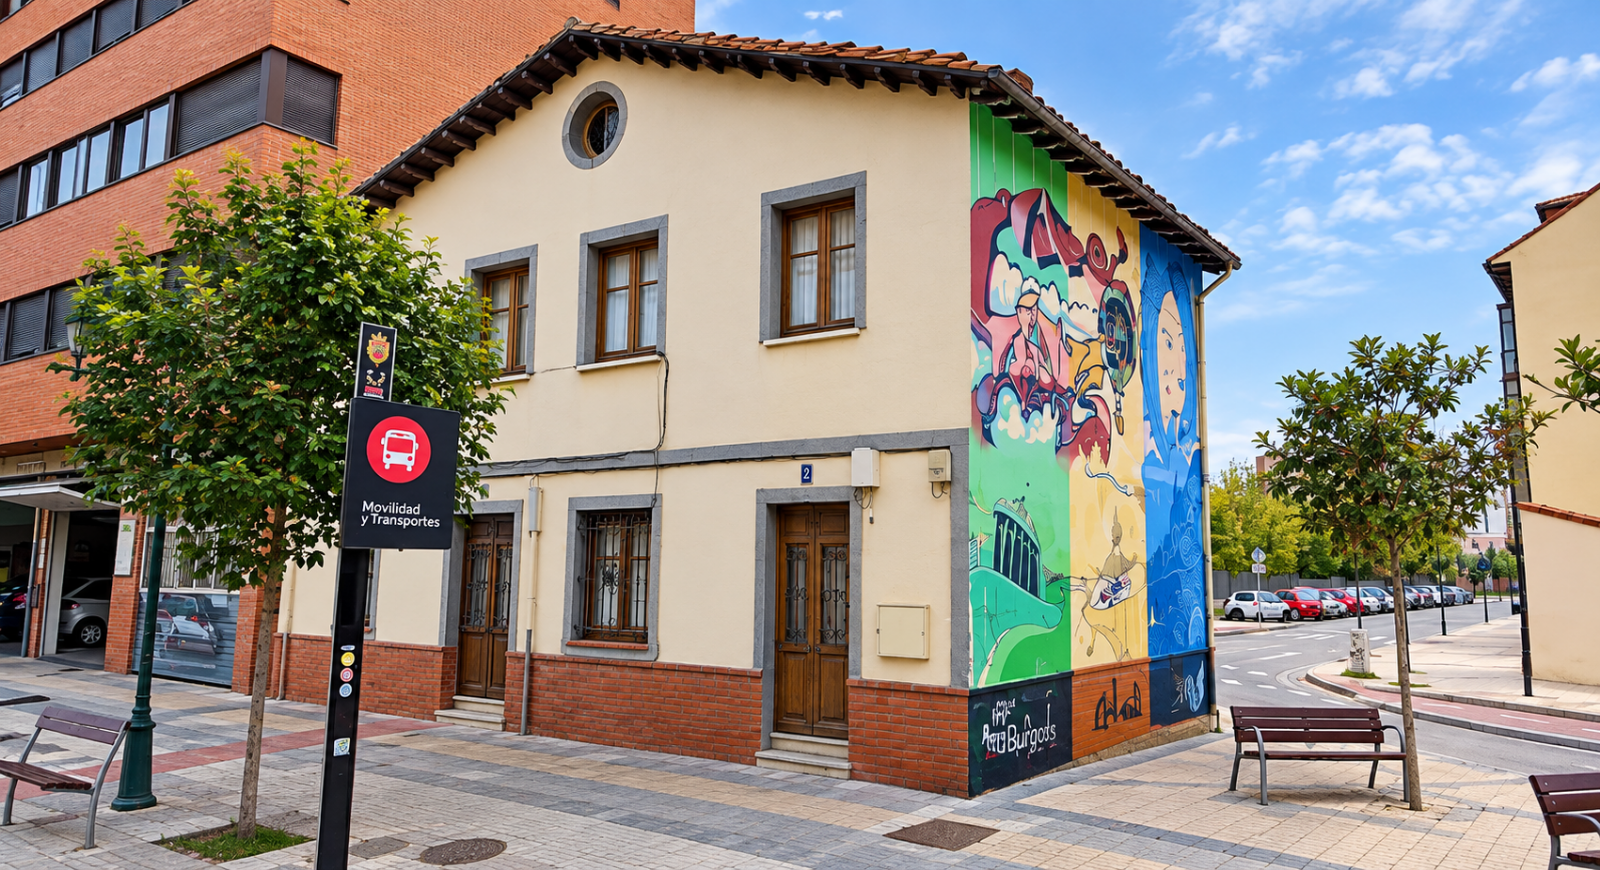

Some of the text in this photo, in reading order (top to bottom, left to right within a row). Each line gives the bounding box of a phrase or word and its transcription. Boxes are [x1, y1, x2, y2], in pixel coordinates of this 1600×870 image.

[803, 467, 810, 480] 2
[362, 500, 421, 515] Movilidad
[361, 513, 440, 529] y Transportes
